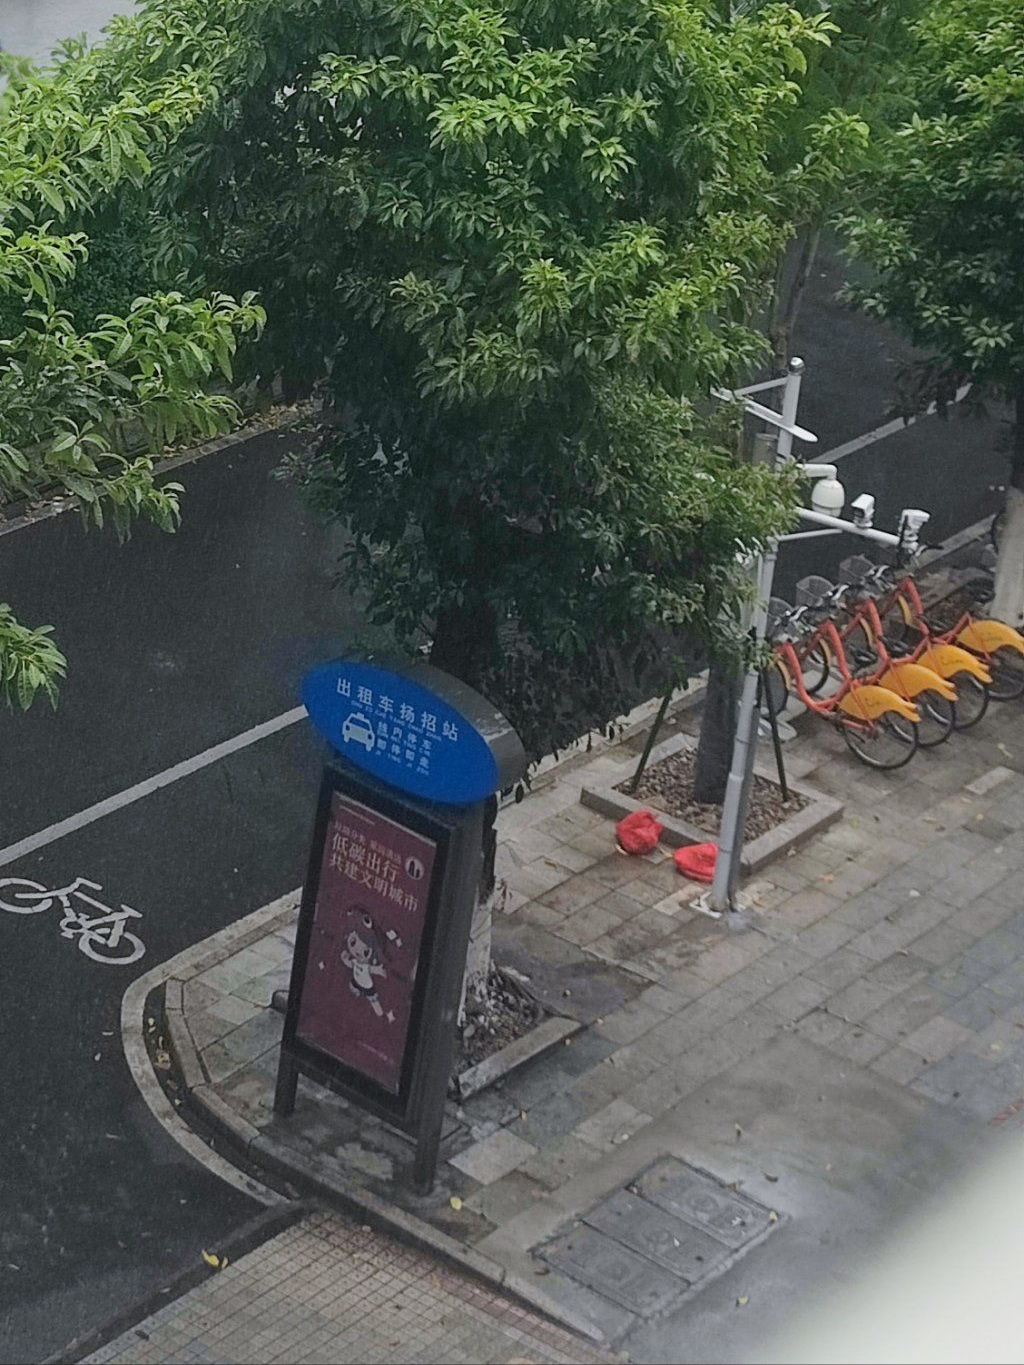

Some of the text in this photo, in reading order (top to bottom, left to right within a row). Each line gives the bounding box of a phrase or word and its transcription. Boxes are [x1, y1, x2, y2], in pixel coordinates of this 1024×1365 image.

[337, 677, 459, 741] 出租车扬招站
[329, 853, 418, 911] 共建文明城市
[333, 832, 399, 882] 低碳出行
